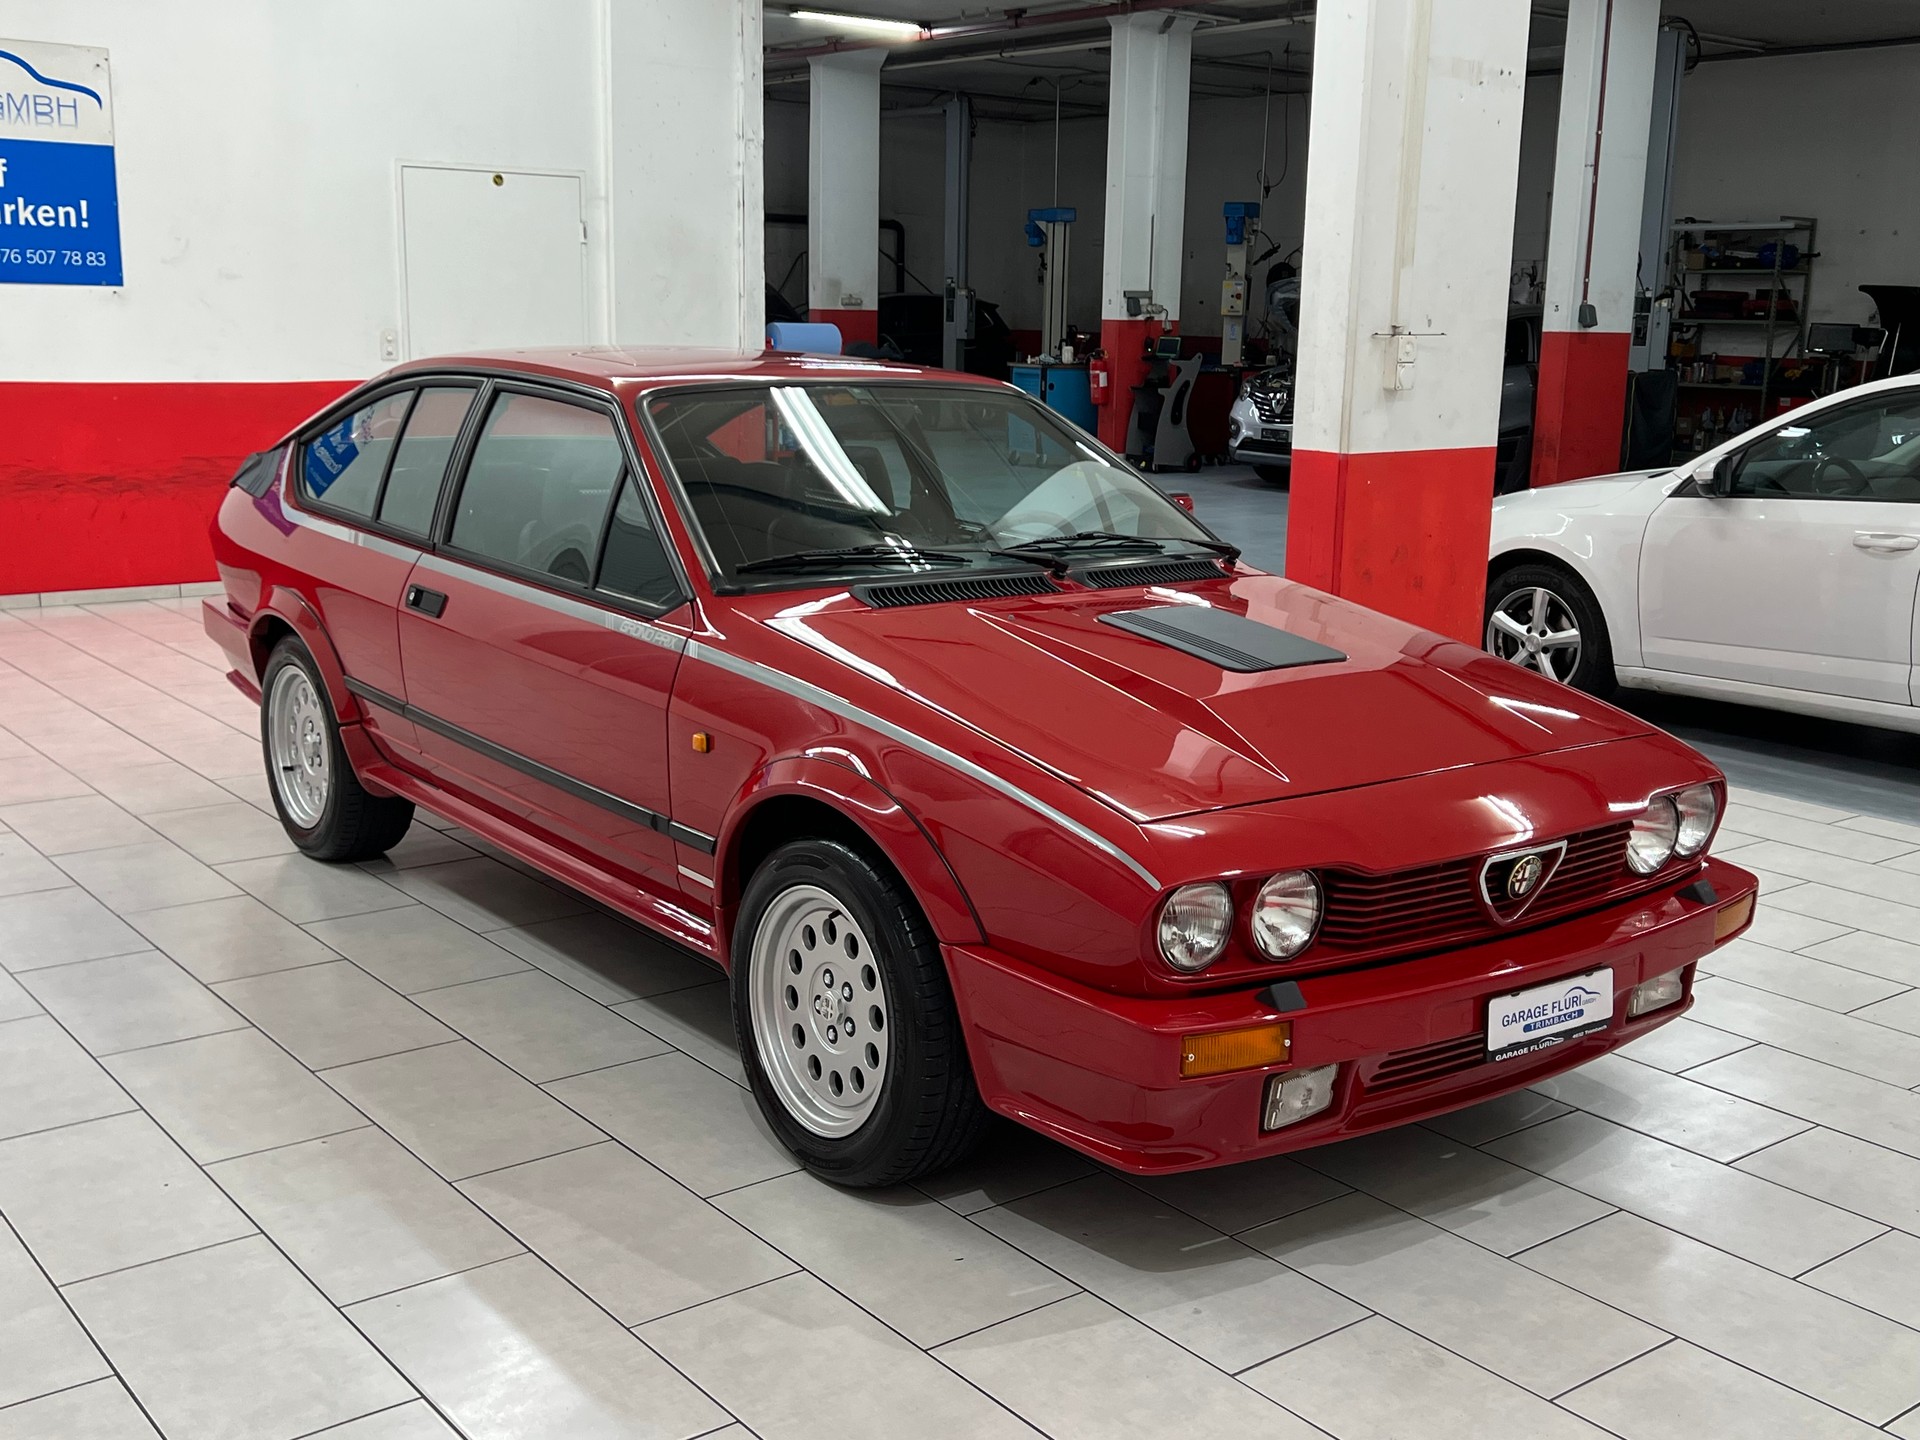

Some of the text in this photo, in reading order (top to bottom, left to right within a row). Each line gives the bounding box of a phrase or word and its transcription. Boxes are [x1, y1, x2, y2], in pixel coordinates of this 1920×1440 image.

[0, 92, 78, 119] MBH
[0, 197, 89, 228] rken!
[0, 248, 106, 266] 76 507 78 83
[1501, 1003, 1549, 1028] GARAGE
[1551, 994, 1582, 1014] FLURI
[1529, 1011, 1579, 1031] TRIMBACH
[1495, 1047, 1529, 1062] GARAGE
